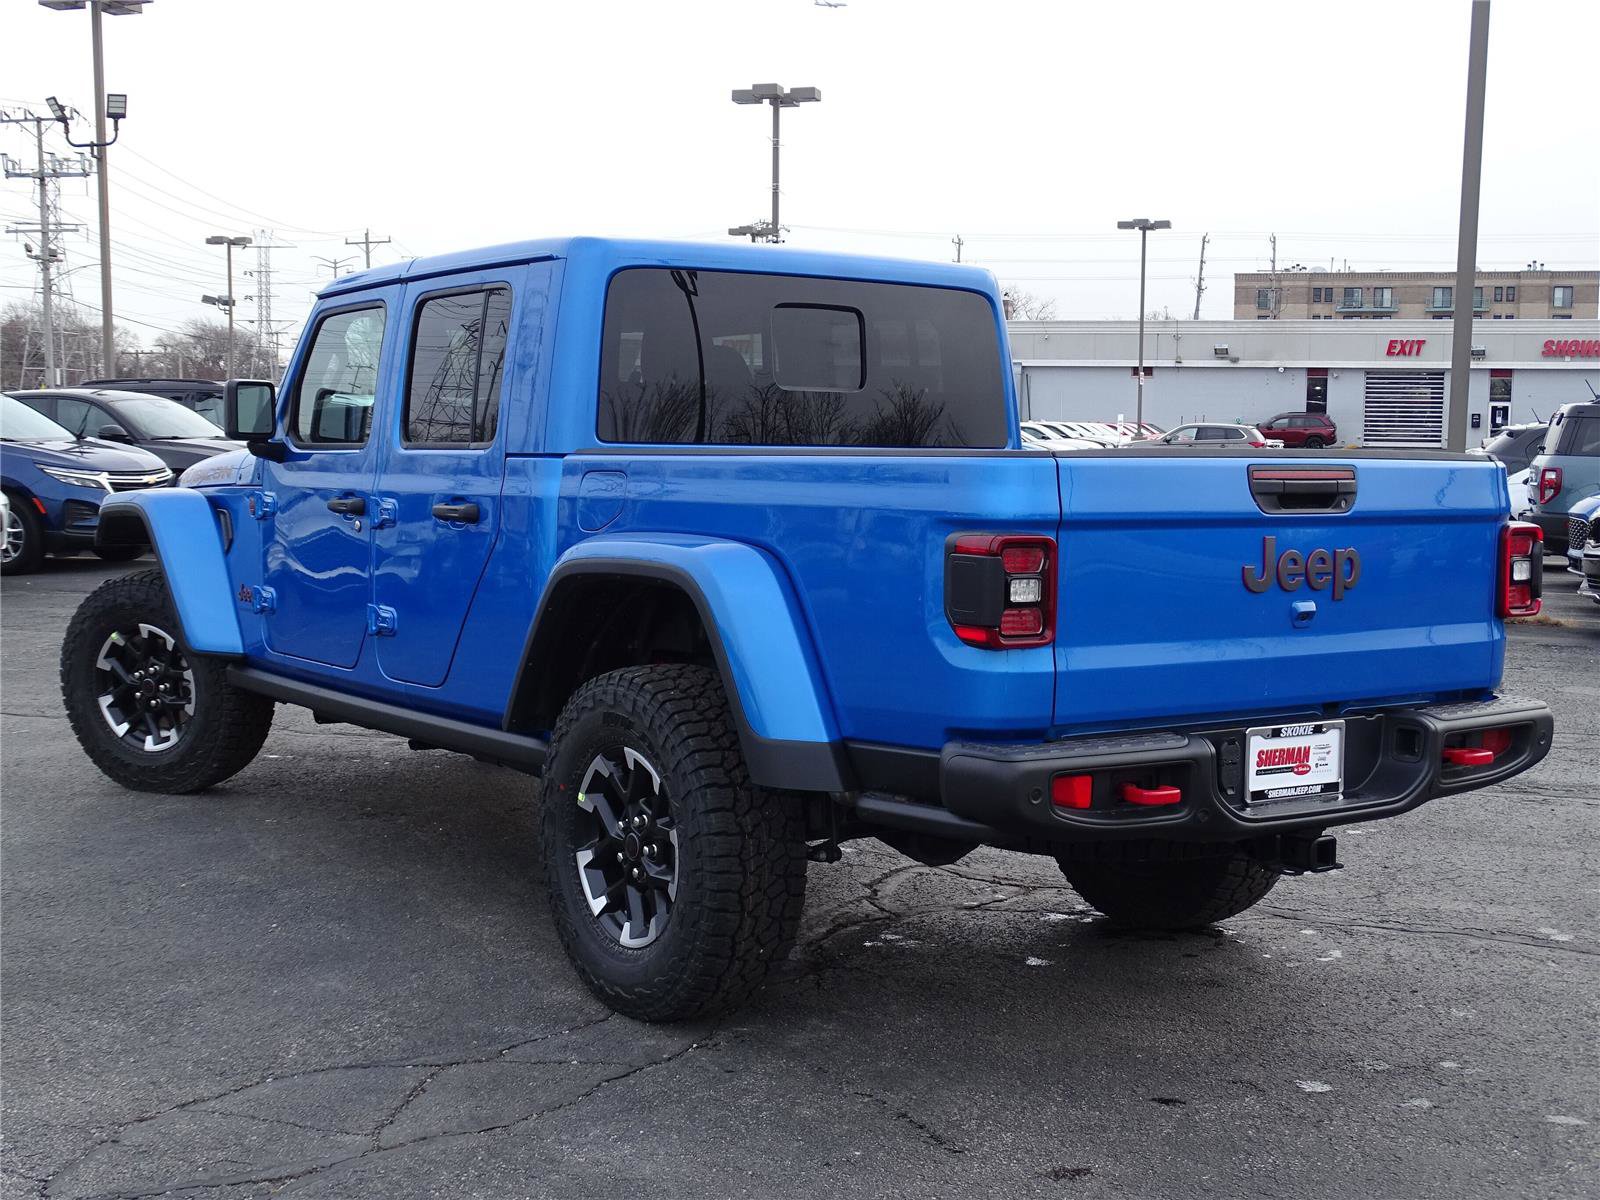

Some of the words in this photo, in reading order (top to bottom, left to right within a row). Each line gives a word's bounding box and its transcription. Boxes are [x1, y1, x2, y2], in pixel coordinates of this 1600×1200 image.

[1385, 339, 1426, 356] EXIT
[1541, 339, 1600, 358] SHOW
[1242, 535, 1361, 601] Jeep
[1280, 725, 1315, 737] SKOKIE
[1256, 746, 1311, 768] SHERMAN
[1268, 785, 1321, 798] SHERMANJEEP.COM
